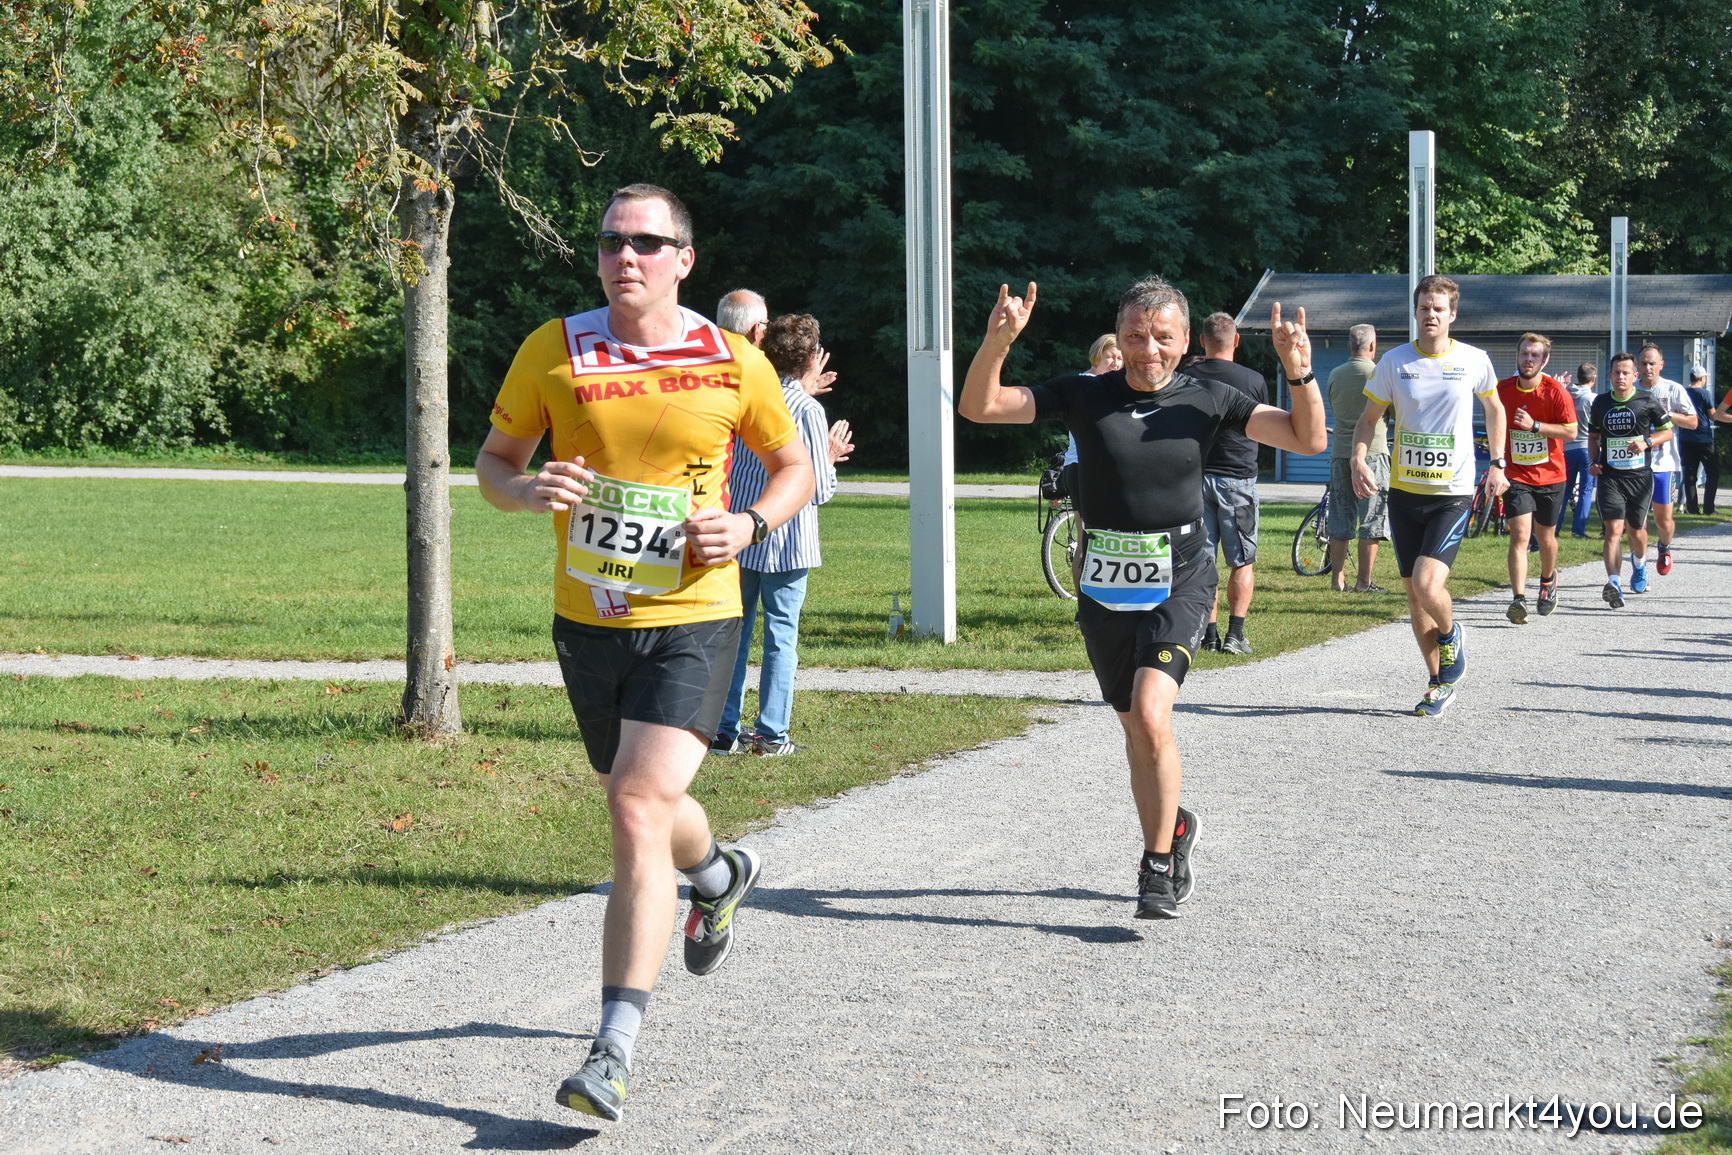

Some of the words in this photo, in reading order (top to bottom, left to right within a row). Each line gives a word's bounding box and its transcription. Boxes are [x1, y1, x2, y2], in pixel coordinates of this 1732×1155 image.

[574, 381, 650, 405] MAX
[658, 370, 740, 393] BÖGL
[1402, 432, 1449, 447] BOCK
[1514, 441, 1543, 453] 1373
[1405, 449, 1448, 467] 1199
[1406, 469, 1443, 479] FLORIAN
[580, 479, 680, 517] BOCK
[581, 512, 669, 559] 1234
[1092, 532, 1162, 556] BOCK
[597, 561, 634, 579] JIRI
[1090, 558, 1160, 583] 2702
